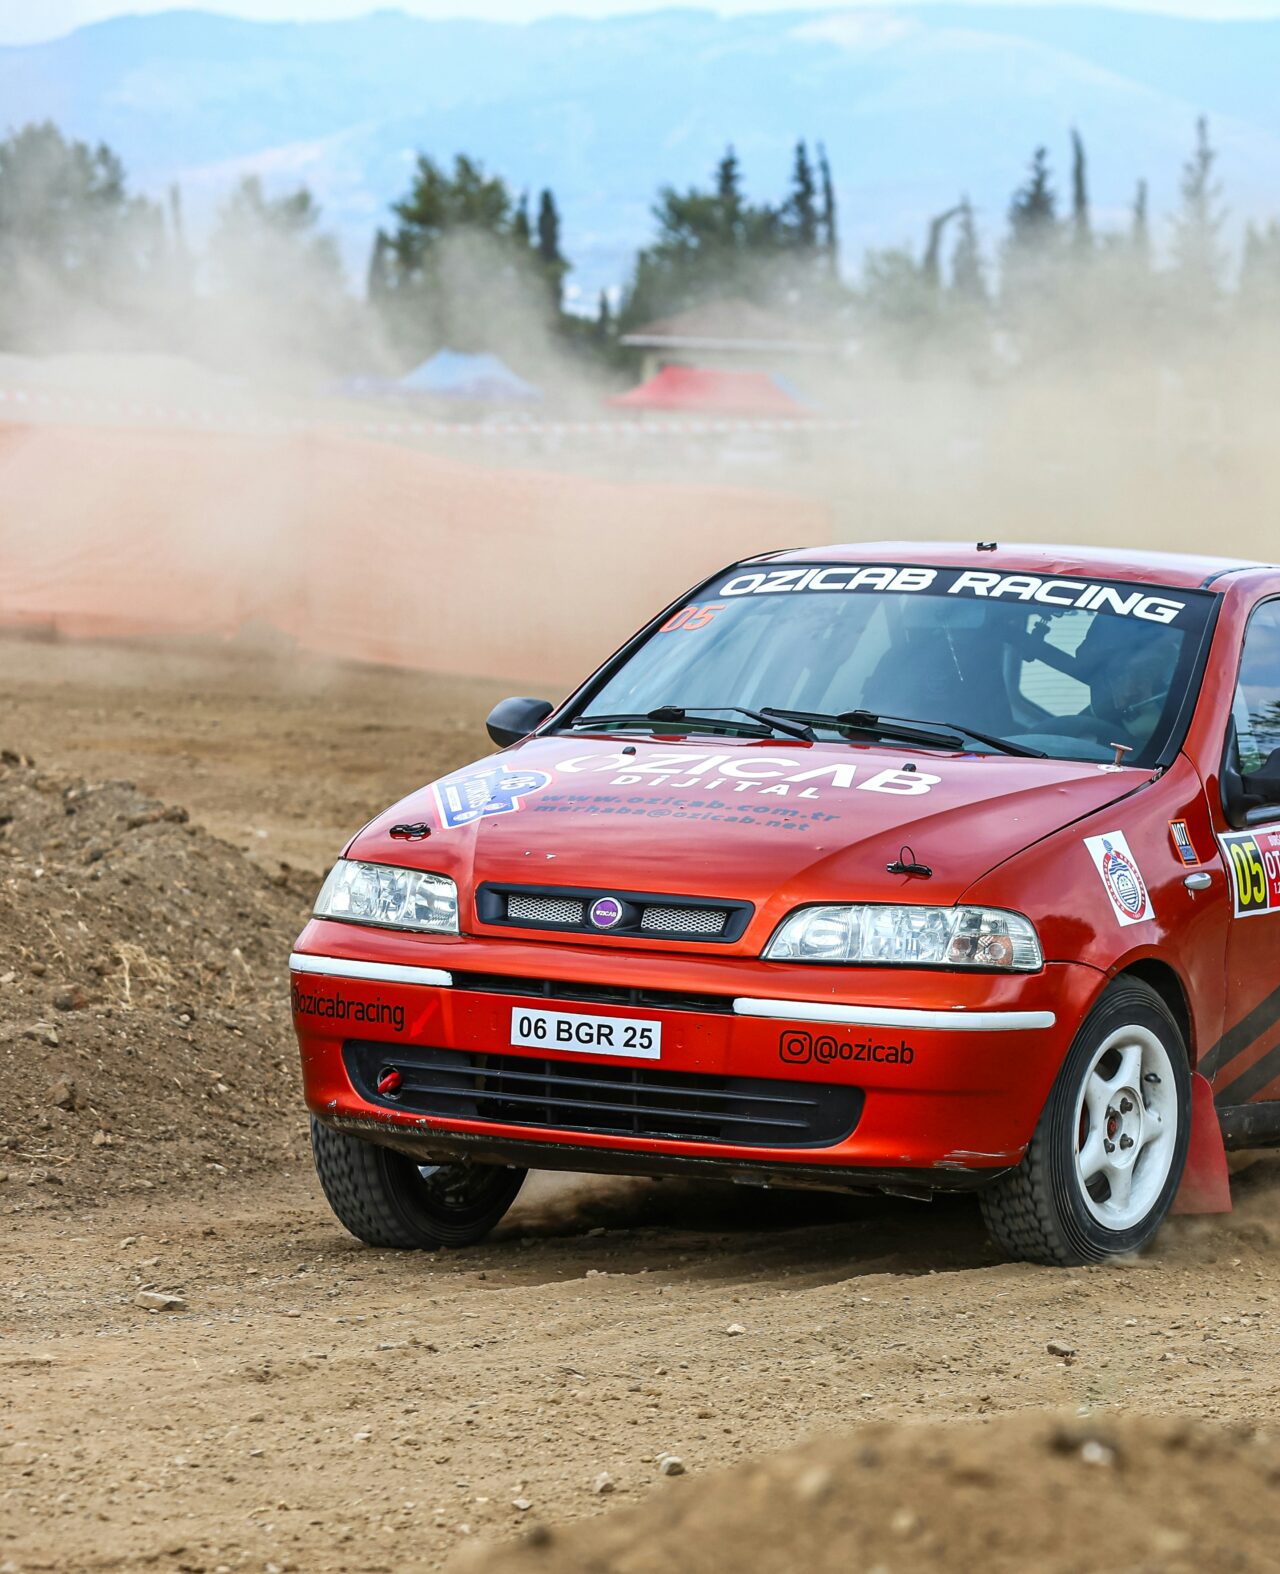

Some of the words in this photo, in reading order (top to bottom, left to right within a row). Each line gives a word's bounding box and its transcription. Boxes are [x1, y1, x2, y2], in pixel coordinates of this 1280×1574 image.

[720, 567, 937, 597] OZICAB
[948, 571, 1185, 624] RACING
[659, 604, 724, 633] 05
[555, 753, 942, 795] OZICAB
[533, 803, 811, 832] merhaba@ozicab.net
[542, 794, 841, 823] www.ozicab.com.tr
[1230, 841, 1266, 905] 05
[519, 1016, 547, 1040] 06
[555, 1020, 614, 1047] BGR
[623, 1026, 653, 1050] 25
[814, 1035, 914, 1065] @ozicab
